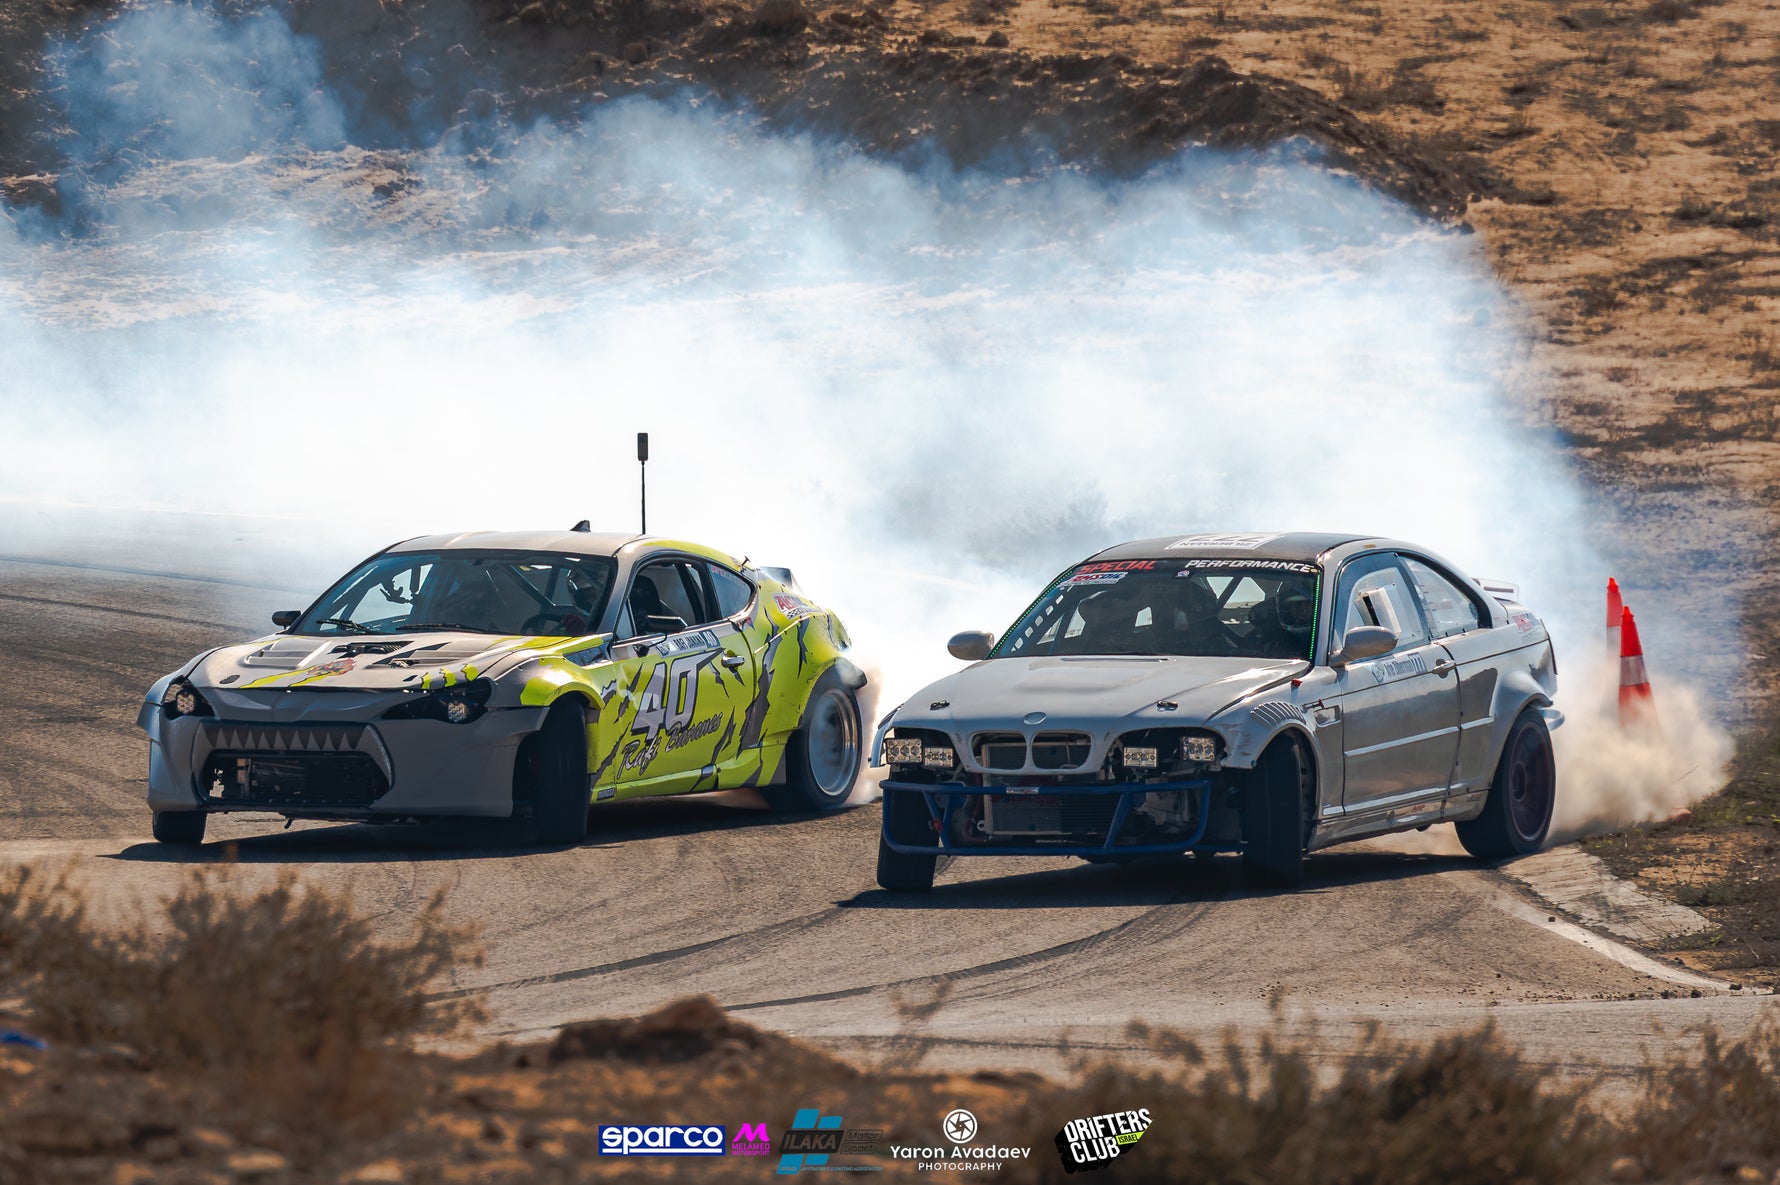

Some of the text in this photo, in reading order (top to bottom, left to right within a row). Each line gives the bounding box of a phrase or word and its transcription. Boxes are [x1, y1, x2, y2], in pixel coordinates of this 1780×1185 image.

[1077, 559, 1312, 574] SPECIAL PERFORMANCE
[631, 647, 725, 744] 40
[616, 735, 662, 780] Rafi
